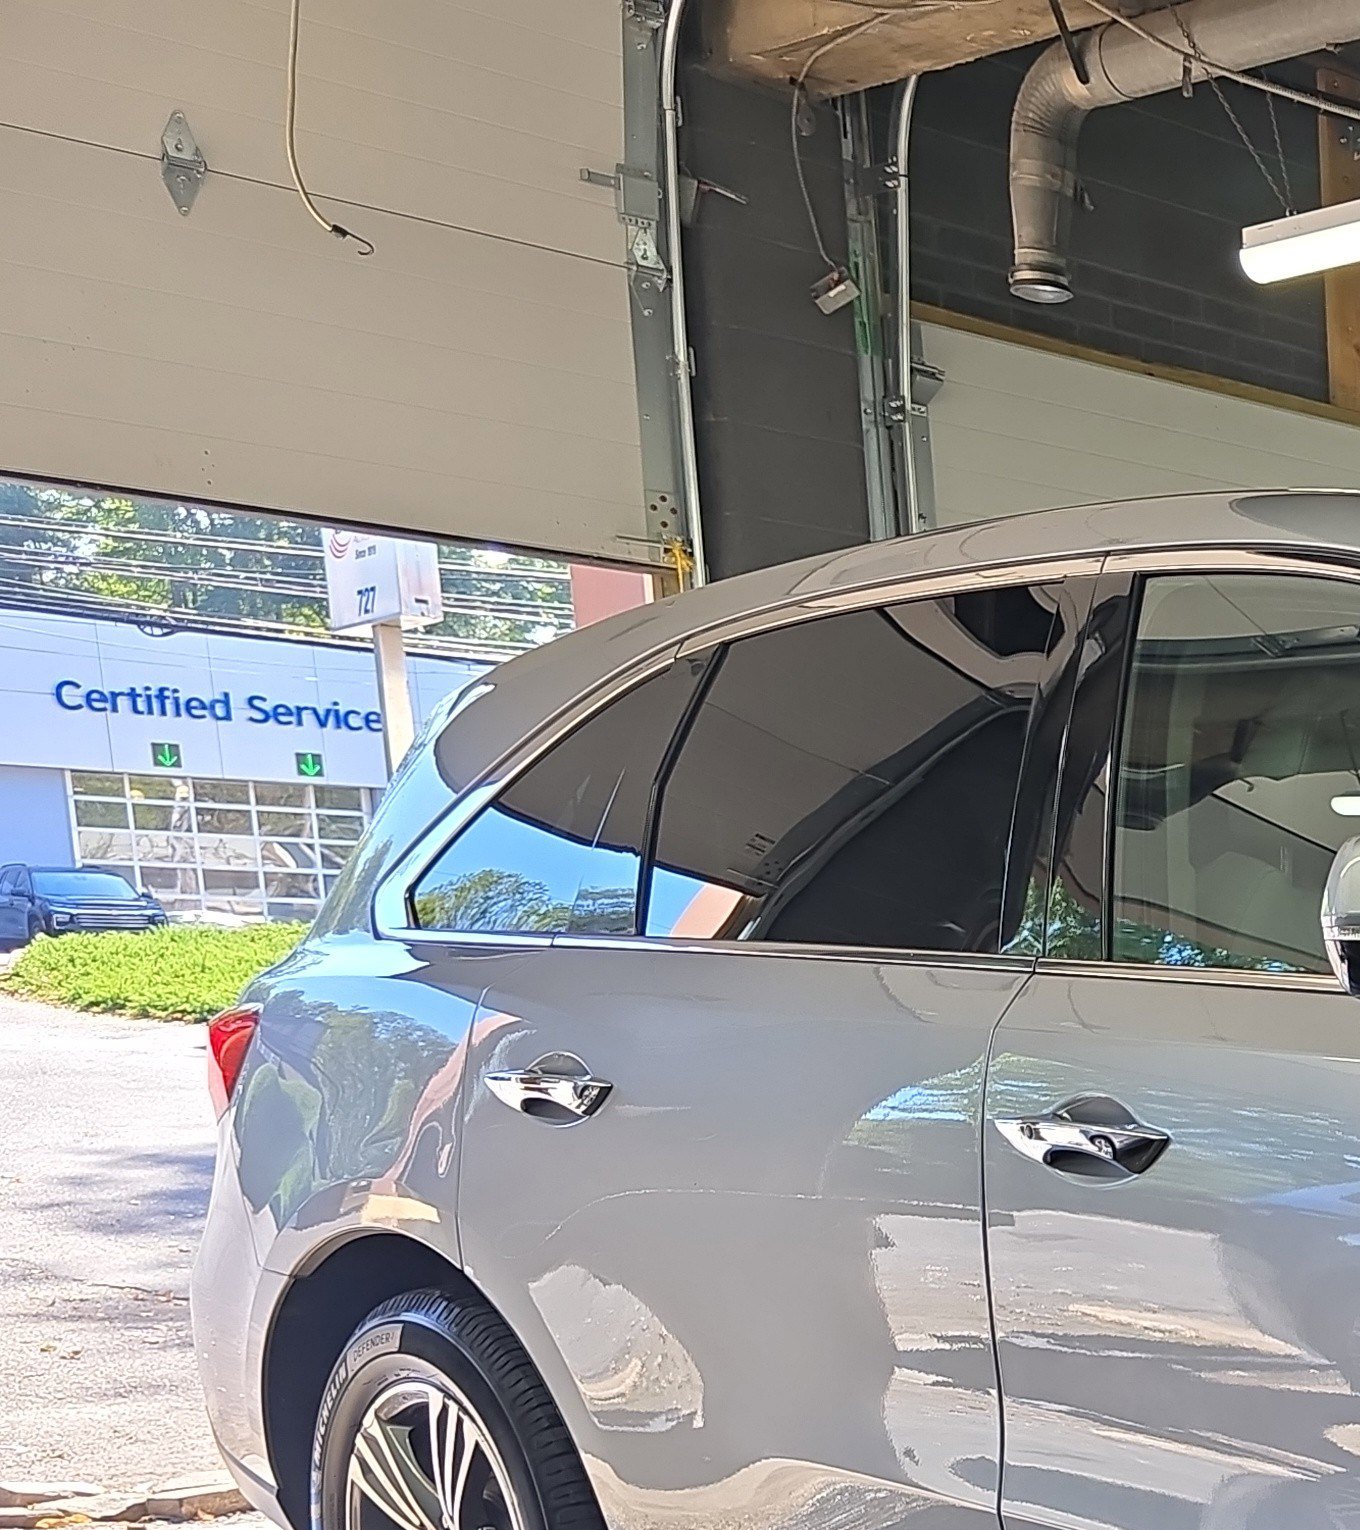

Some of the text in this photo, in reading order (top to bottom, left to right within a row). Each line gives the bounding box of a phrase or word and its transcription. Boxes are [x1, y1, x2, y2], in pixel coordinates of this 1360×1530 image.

[357, 586, 376, 617] 727
[55, 680, 383, 732] Certified Service
